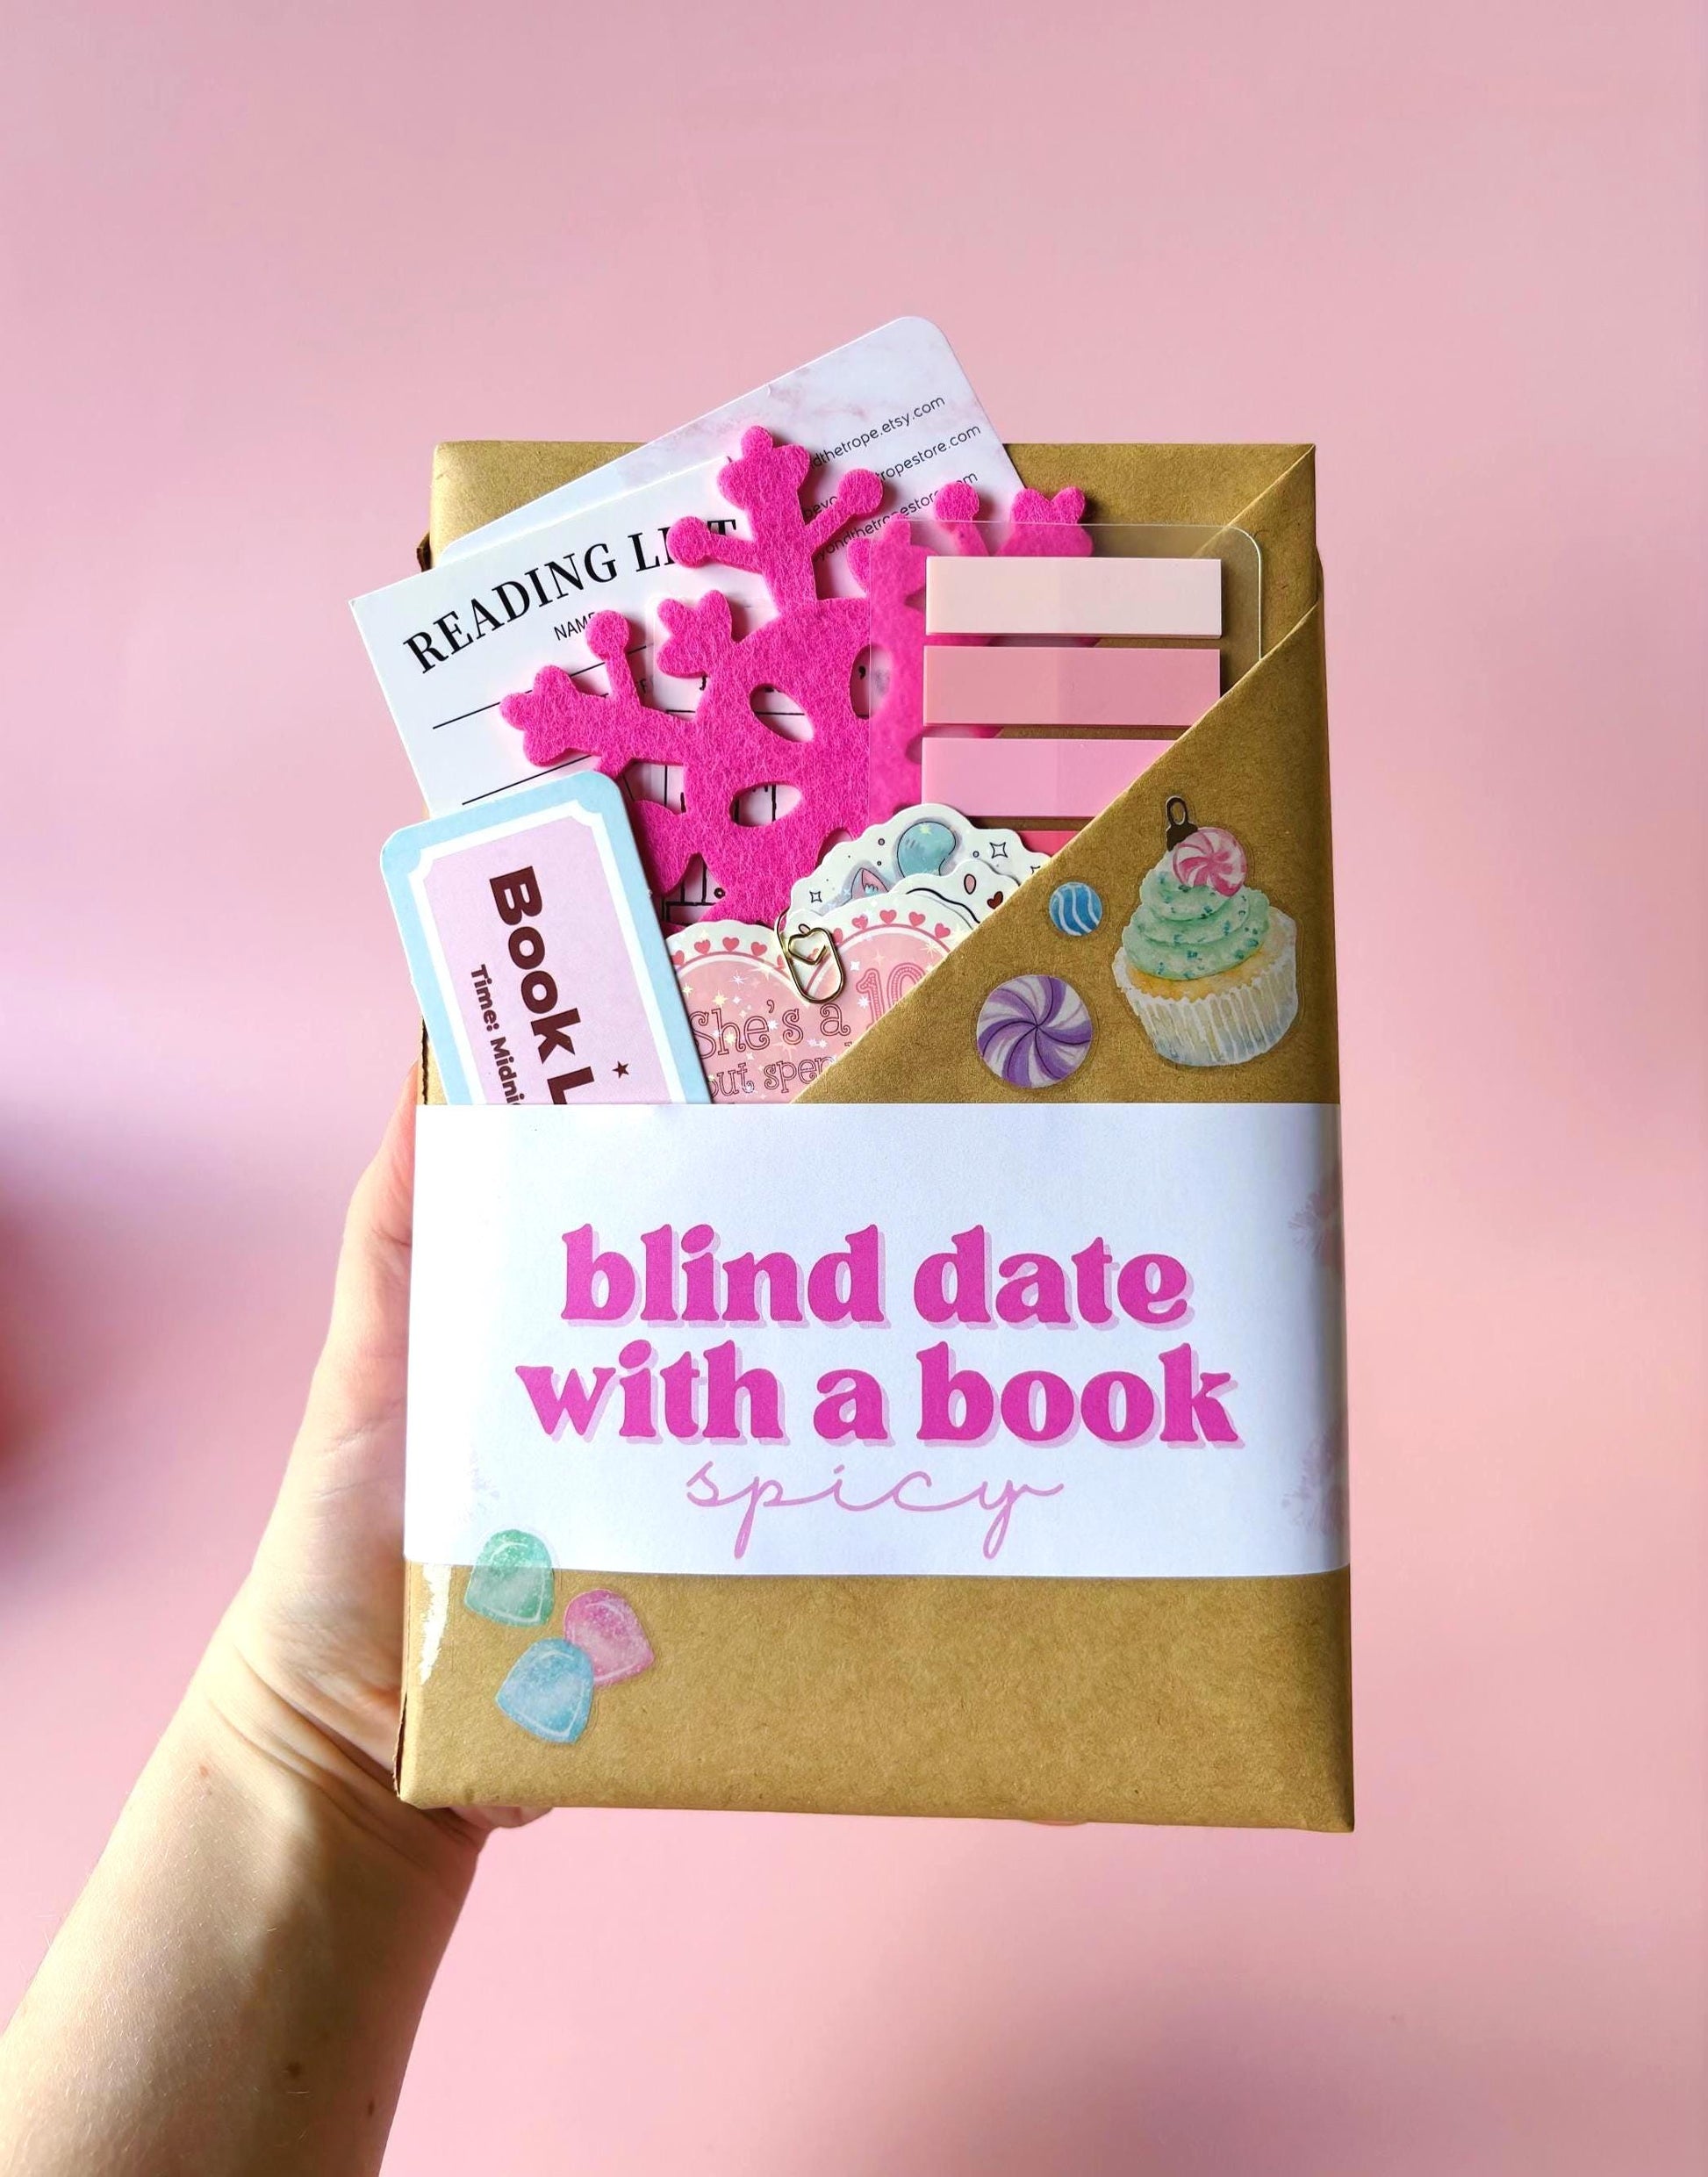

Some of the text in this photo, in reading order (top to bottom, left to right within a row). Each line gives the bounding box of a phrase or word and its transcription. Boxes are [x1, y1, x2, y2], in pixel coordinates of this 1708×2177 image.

[810, 396, 945, 470] dthetrope.etsy.com
[403, 519, 737, 674] READING LIT
[554, 611, 595, 641] NAM
[489, 866, 581, 1065] Book
[470, 963, 525, 1104] Time: Midni
[689, 999, 804, 1060] She's
[820, 1002, 850, 1037] a
[763, 1042, 852, 1095] spen
[561, 1224, 1194, 1330] blind date
[515, 1340, 1242, 1447] with a book
[686, 1461, 1065, 1559] spicy
